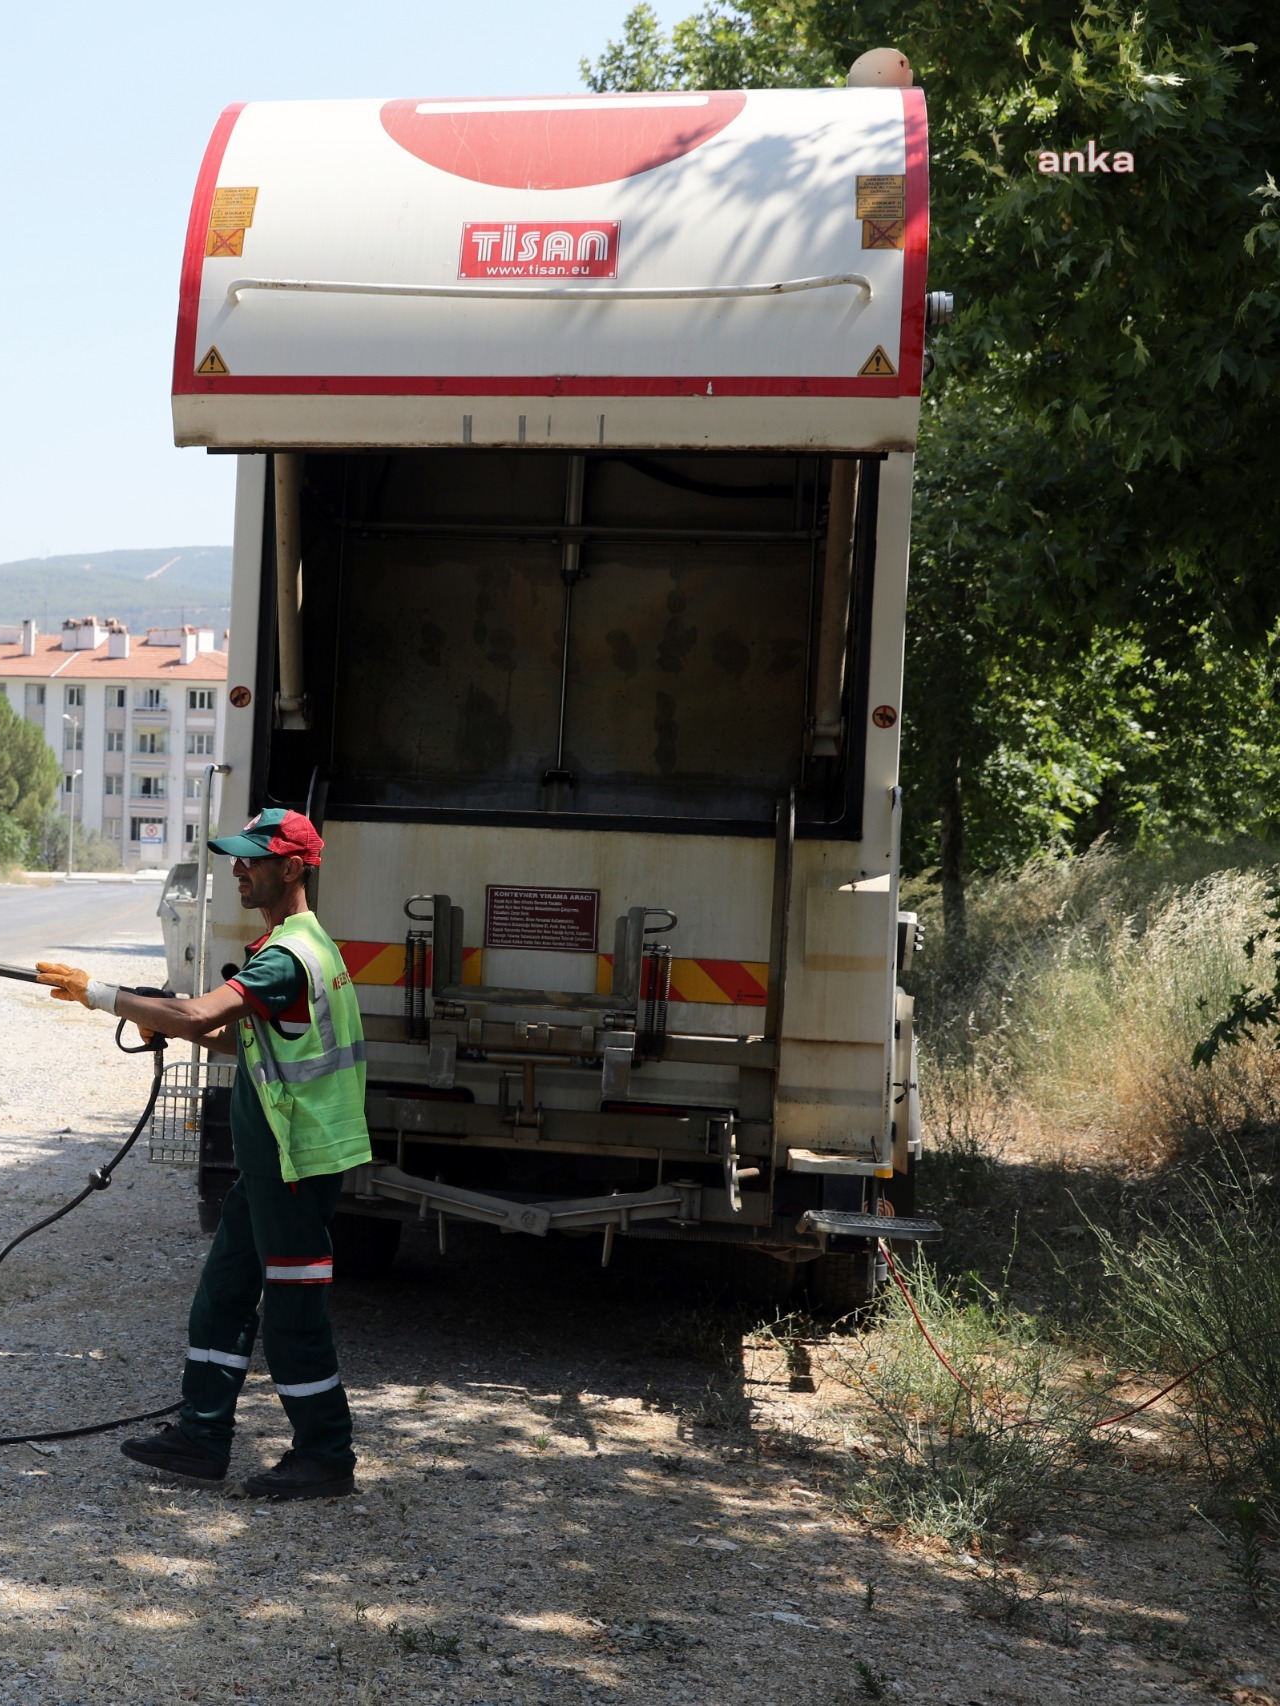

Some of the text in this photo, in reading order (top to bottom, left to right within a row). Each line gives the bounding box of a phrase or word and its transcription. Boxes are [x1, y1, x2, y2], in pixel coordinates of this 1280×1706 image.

[472, 225, 608, 261] TİSAN
[486, 264, 589, 275] www.tisan.eu
[494, 891, 538, 899] KONTEYNER
[569, 893, 592, 901] ARACI
